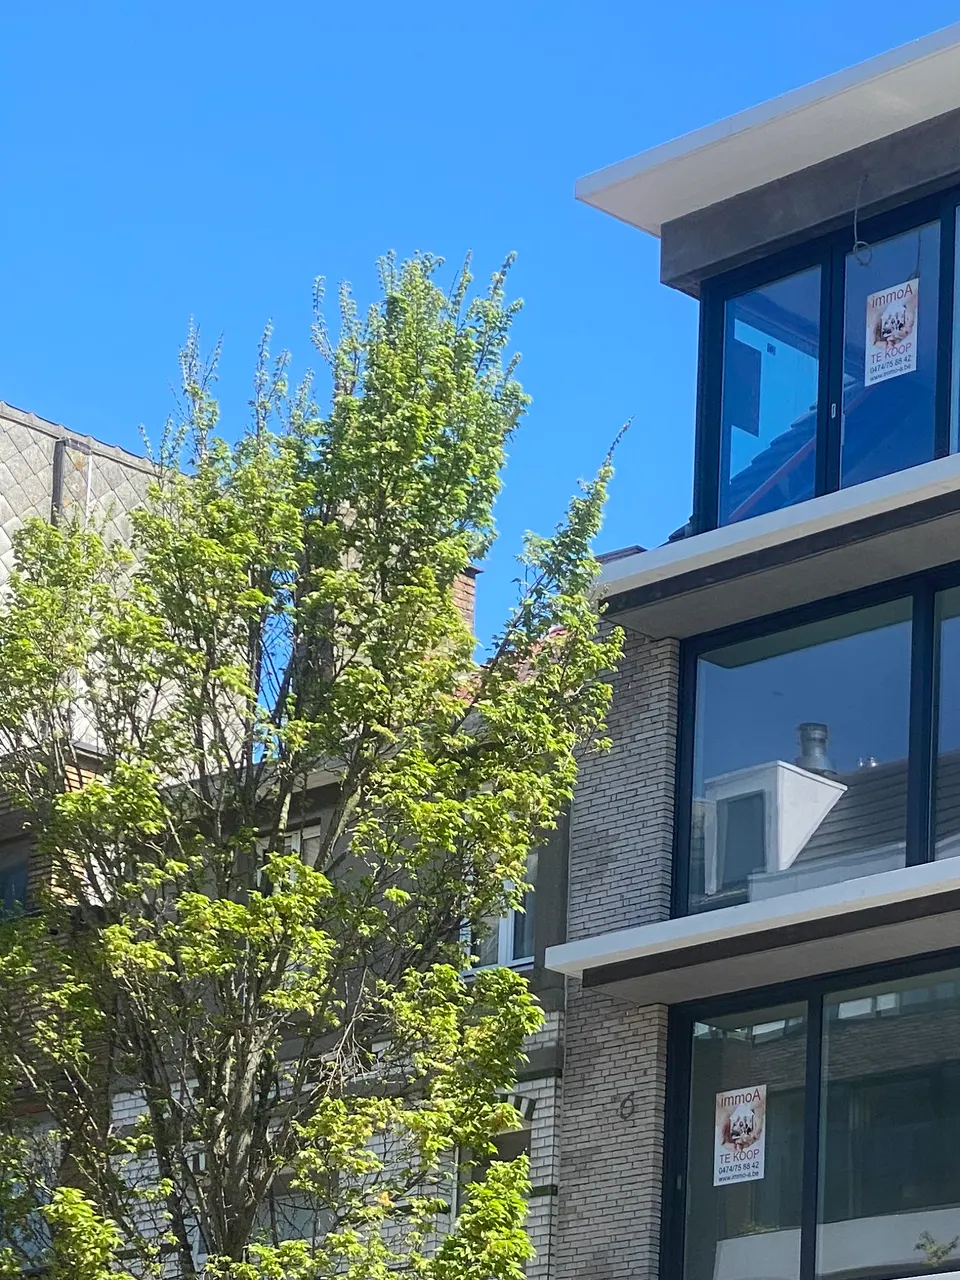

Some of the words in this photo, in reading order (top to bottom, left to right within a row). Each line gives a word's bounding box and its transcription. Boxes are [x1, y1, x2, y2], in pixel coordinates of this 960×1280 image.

[872, 283, 912, 308] immoA
[871, 352, 882, 364] TE
[884, 342, 912, 360] KOOP
[721, 1088, 761, 1108] immoA
[720, 1154, 731, 1164] TE
[733, 1148, 759, 1162] KOOP
[718, 1164, 741, 1174] 0474/75
[752, 1161, 759, 1169] 42
